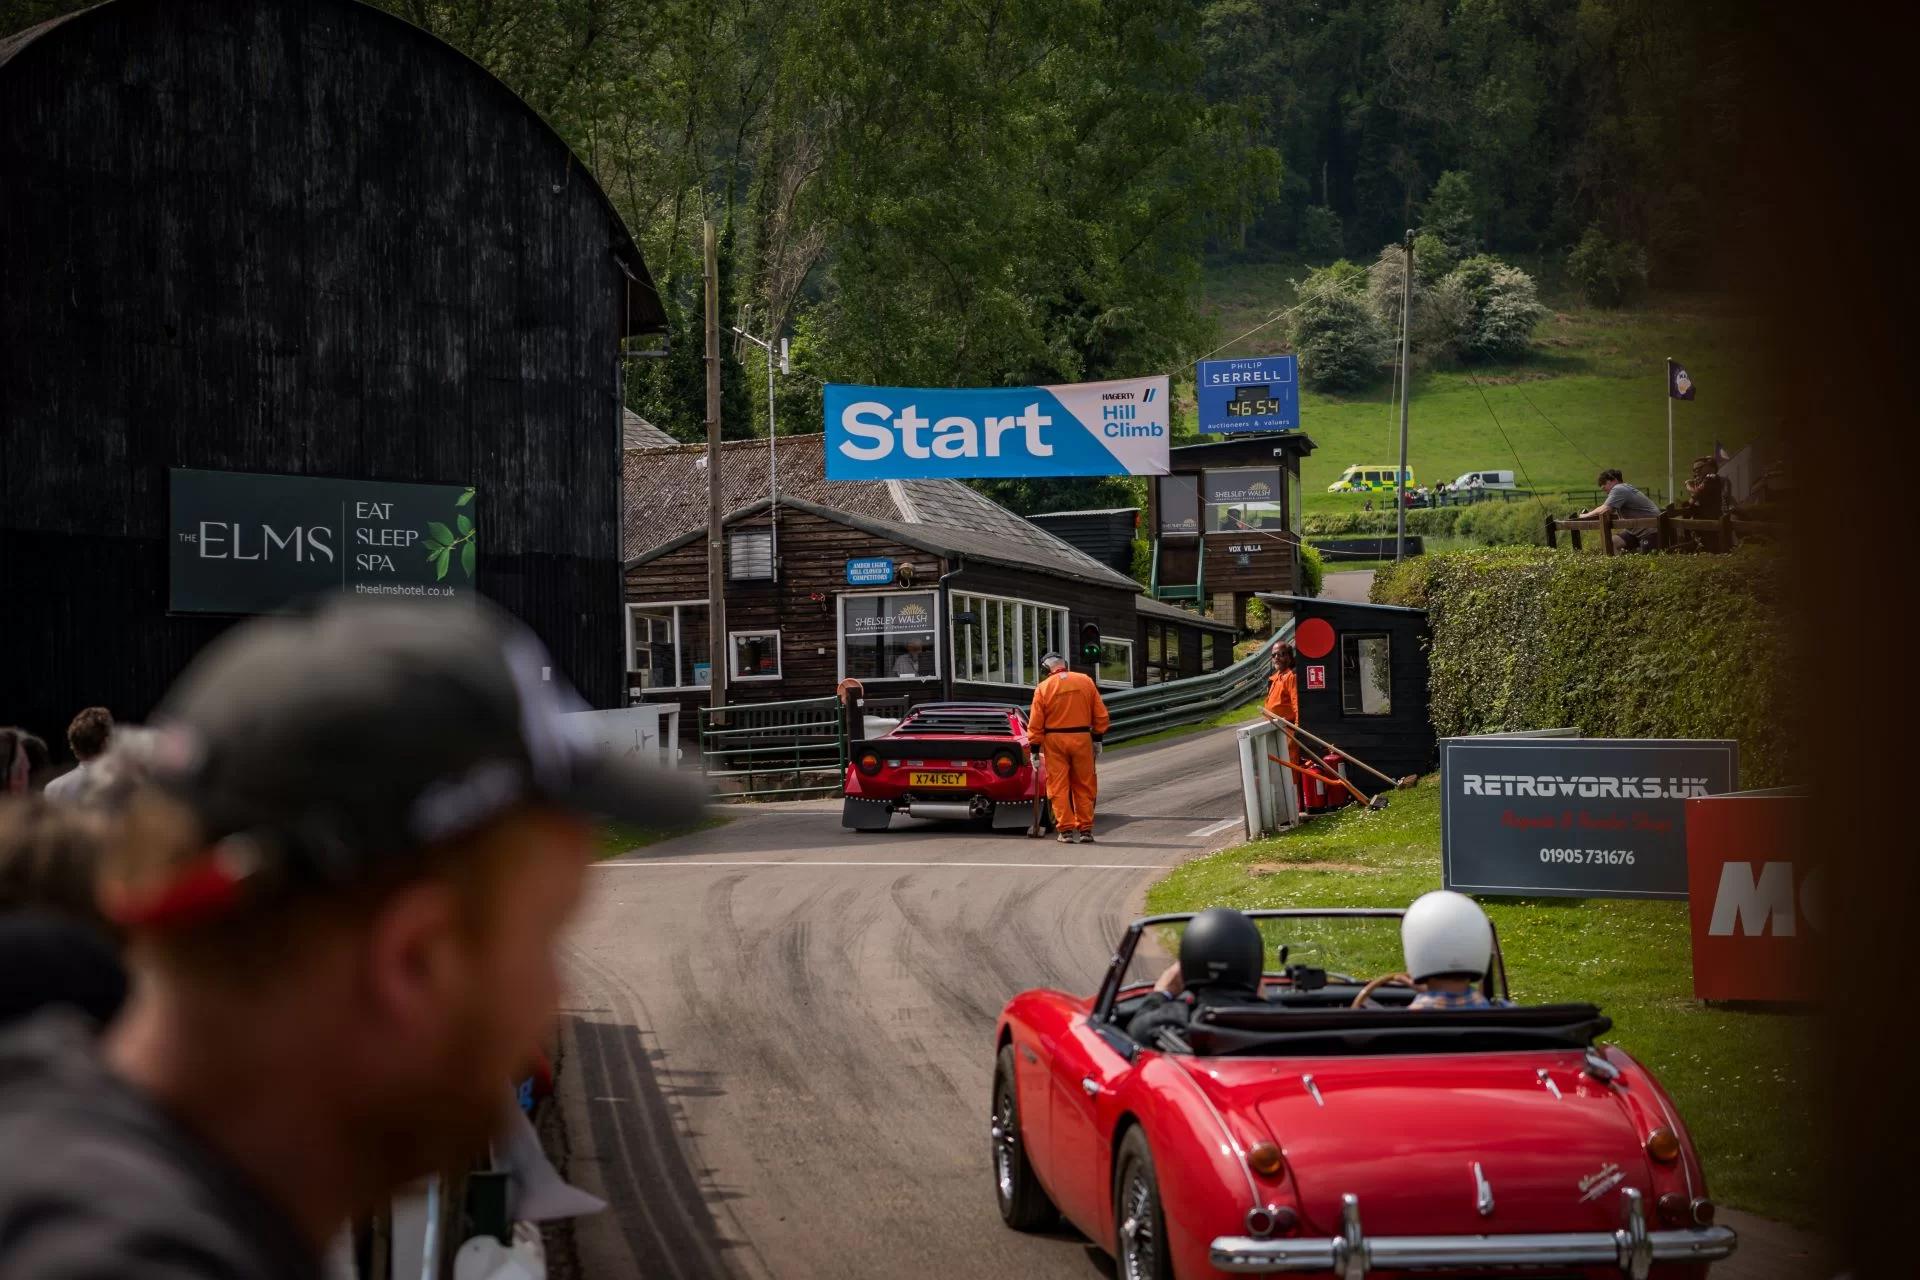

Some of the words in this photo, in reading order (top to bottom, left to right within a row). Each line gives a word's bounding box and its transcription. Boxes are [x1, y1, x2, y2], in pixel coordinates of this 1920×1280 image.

[1231, 362, 1262, 370] PHILIP
[1212, 370, 1281, 383] SERRELL
[1102, 393, 1135, 401] HAGERTY
[1103, 404, 1136, 420] Hill
[838, 401, 1054, 461] Start
[1104, 421, 1164, 438] Climb
[1207, 421, 1249, 429] auctioneers
[1214, 490, 1246, 499] SHELSLEY
[1247, 489, 1271, 497] WALSH
[356, 501, 394, 520] EAT
[178, 533, 198, 543] THE
[200, 521, 334, 563] ELMS
[356, 527, 419, 547] SLEEP
[356, 553, 396, 572] SPA
[355, 583, 455, 597] theelmshotel.co.uk
[855, 616, 896, 627] SHELSLEY
[898, 614, 928, 624] WALSH
[916, 774, 939, 785] X741
[940, 774, 961, 784] SCY
[1463, 774, 1709, 799] RETROWORKS.UK
[1539, 848, 1583, 864] 01905
[1585, 849, 1635, 865] 731676
